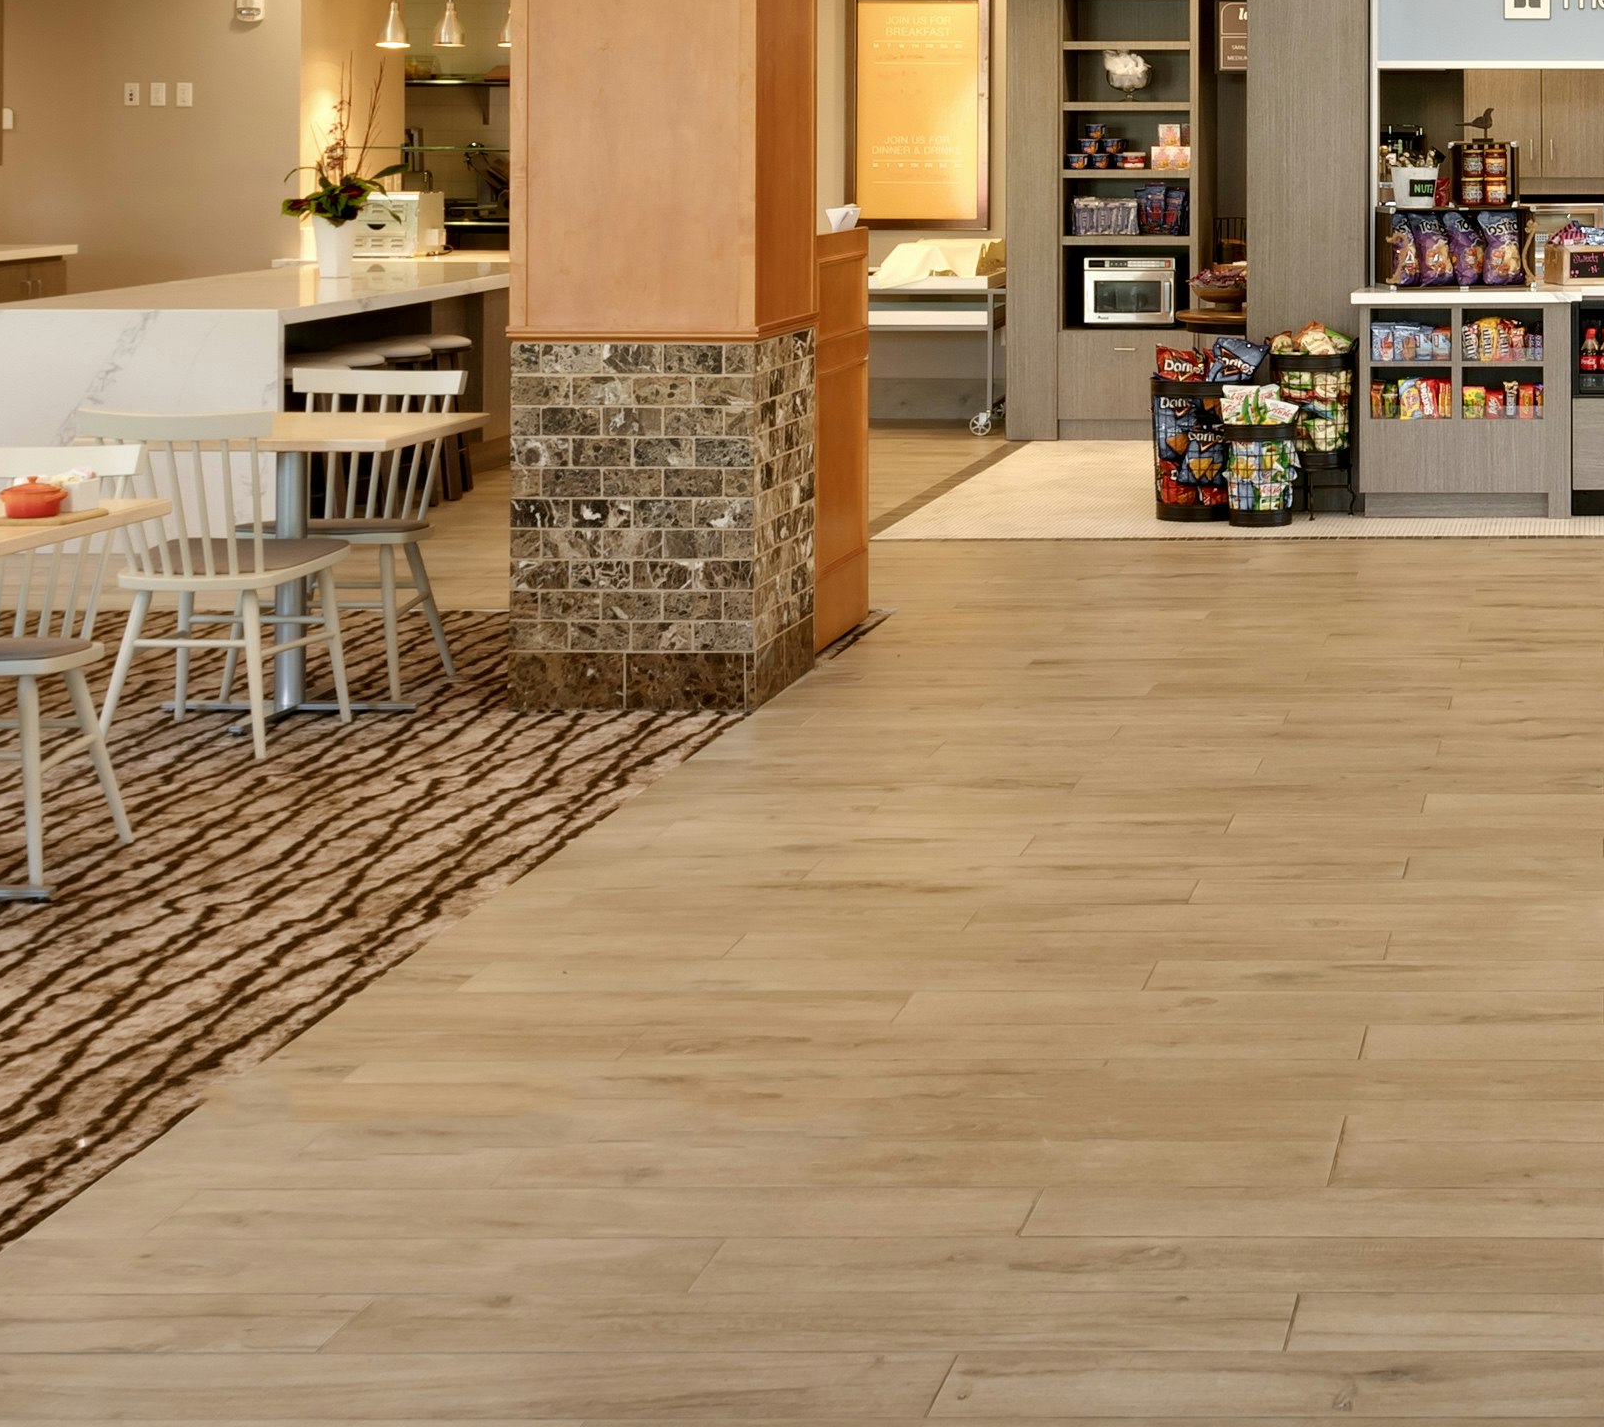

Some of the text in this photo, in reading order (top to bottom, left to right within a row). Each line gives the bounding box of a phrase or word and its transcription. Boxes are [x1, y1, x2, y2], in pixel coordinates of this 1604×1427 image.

[886, 16, 951, 25] JOIN US FOR
[885, 27, 952, 36] BREAKFAST
[884, 135, 950, 145] JOIN US FOR
[871, 146, 961, 155] DINNER & DRINKS
[1572, 252, 1599, 264] Sweets
[1221, 357, 1256, 375] oritos
